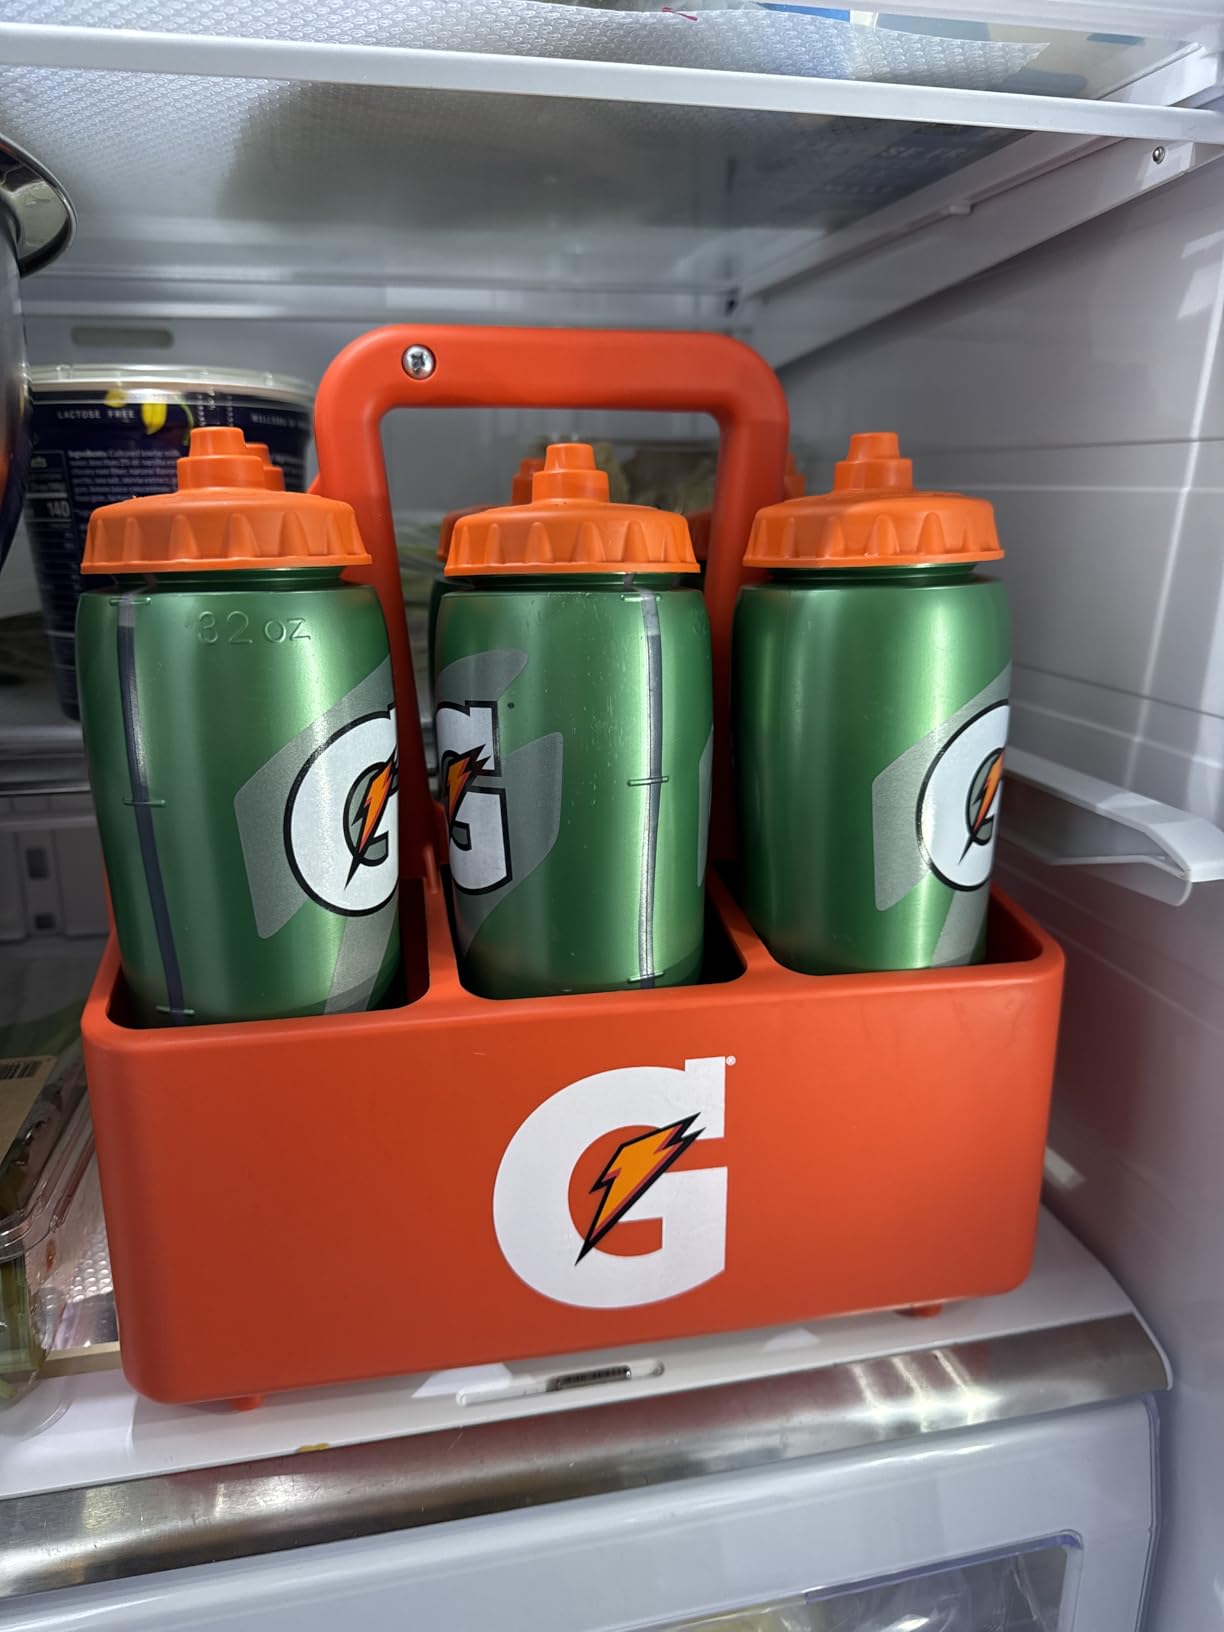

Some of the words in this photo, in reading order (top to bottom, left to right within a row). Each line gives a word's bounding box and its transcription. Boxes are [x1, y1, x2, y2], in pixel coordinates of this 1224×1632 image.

[57, 409, 101, 419] LACTOSE
[107, 409, 135, 419] FREE
[198, 611, 254, 645] 32
